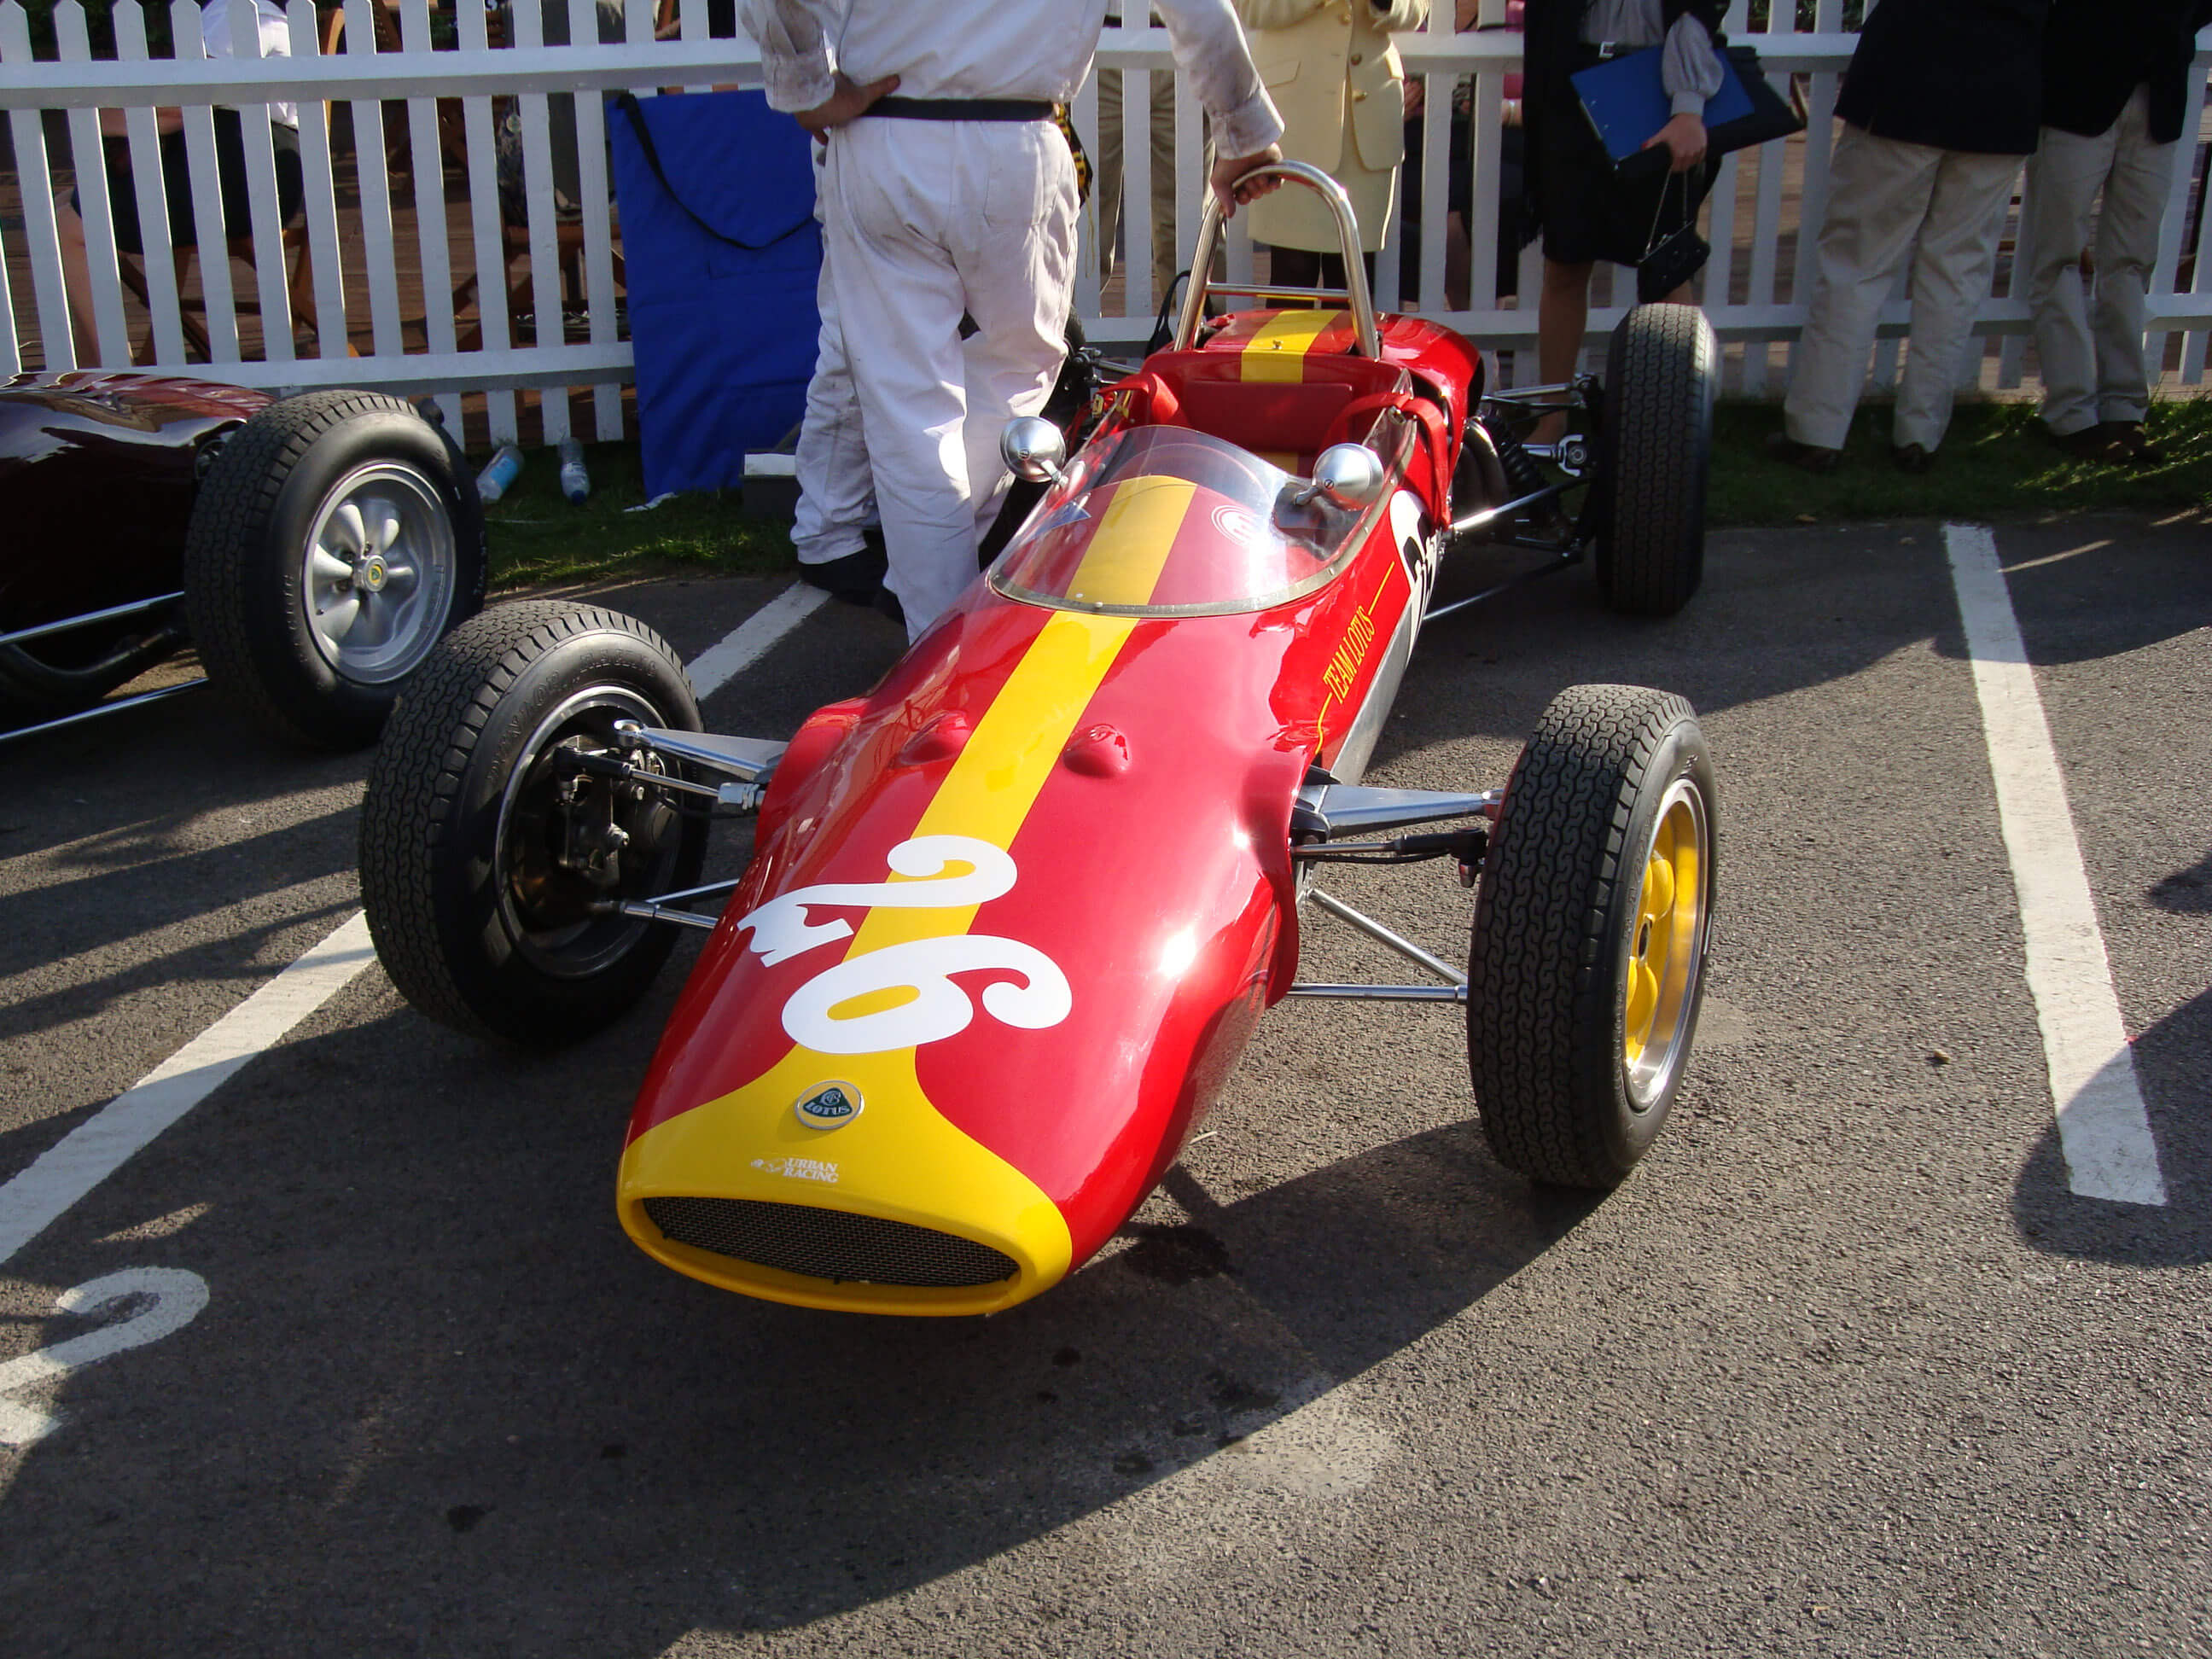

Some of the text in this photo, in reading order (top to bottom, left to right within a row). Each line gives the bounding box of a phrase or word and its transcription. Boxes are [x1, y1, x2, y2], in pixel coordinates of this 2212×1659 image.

[1323, 605, 1376, 705] TEAM LOTUS
[737, 835, 1073, 1055] 26
[805, 1102, 851, 1115] LOTUS
[785, 1157, 839, 1173] URBAN
[783, 1167, 840, 1184] RACING
